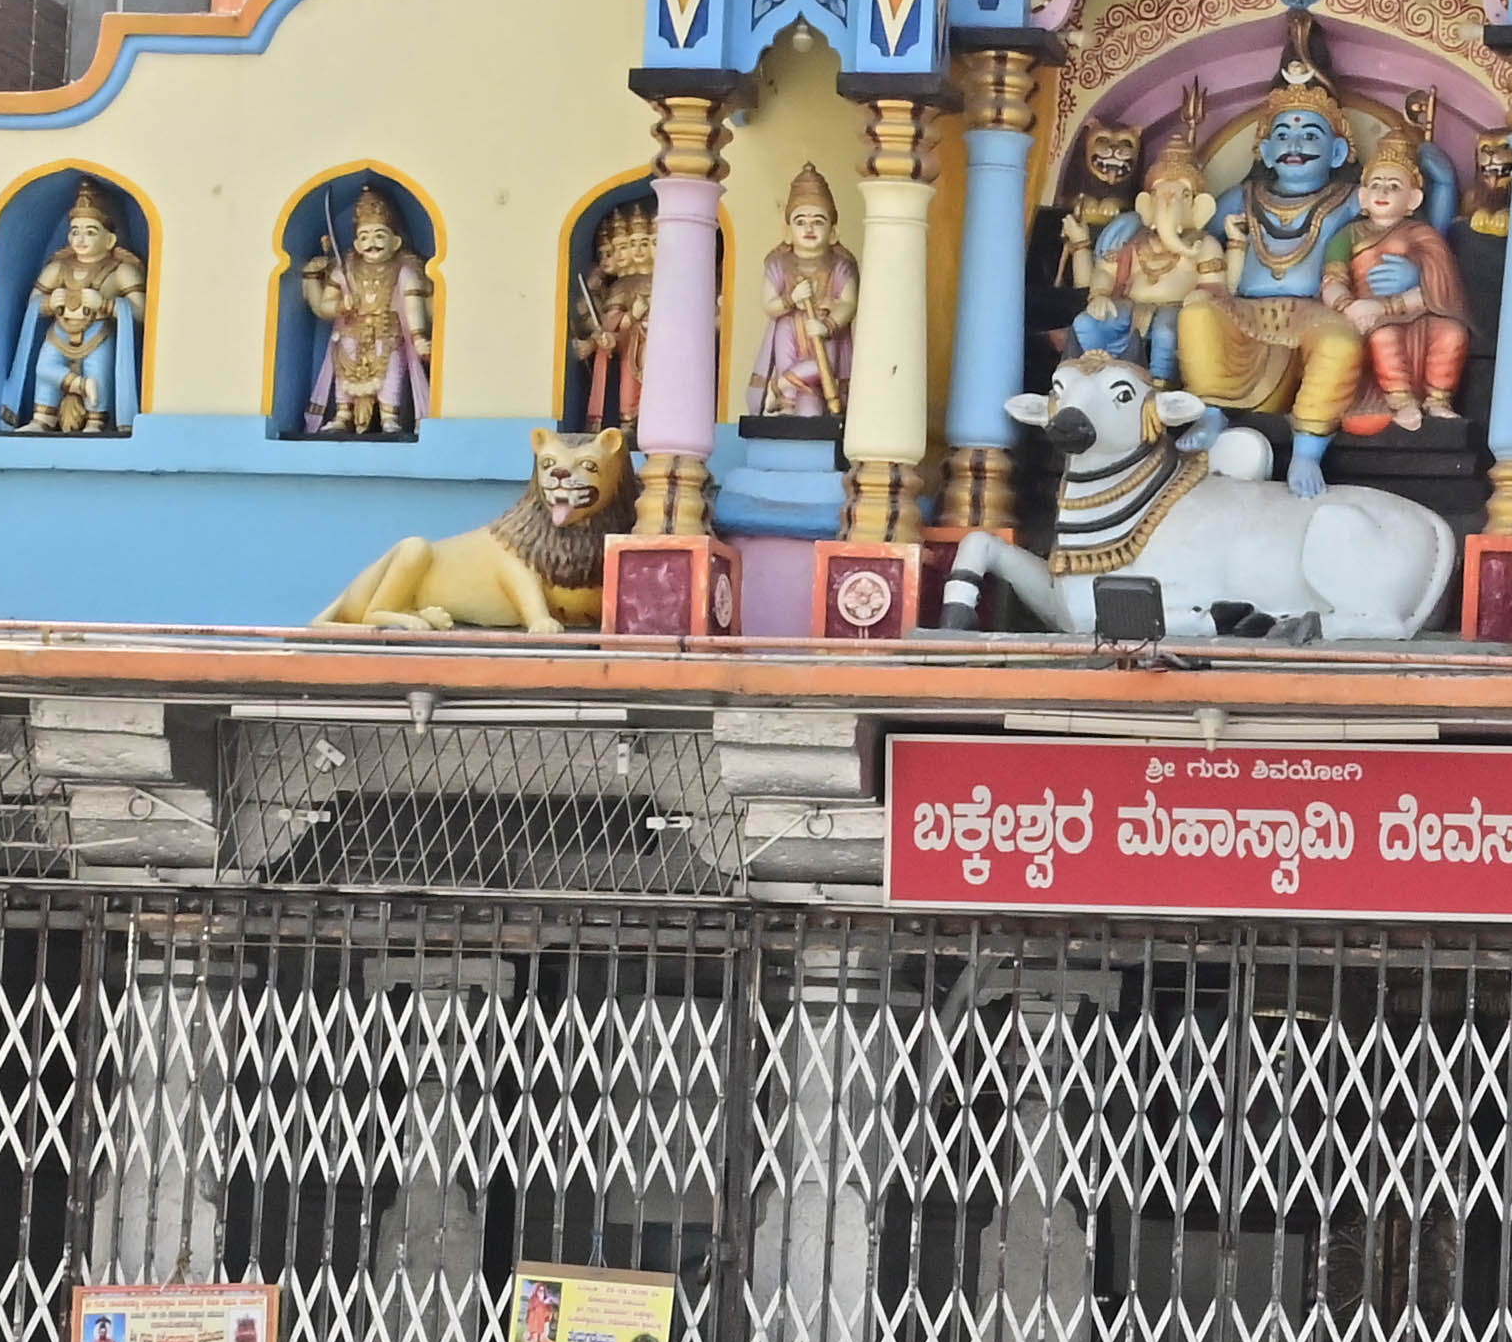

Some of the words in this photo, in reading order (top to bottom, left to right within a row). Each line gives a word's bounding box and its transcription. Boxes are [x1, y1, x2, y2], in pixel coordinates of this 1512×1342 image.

[1146, 758, 1175, 783] ಶ್ರೀ
[1188, 758, 1239, 778] ಗುರು
[1252, 760, 1362, 780] ಶಿವಯೋಗಿ
[914, 786, 1093, 888] ಬಕ್ಕೇಶ್ವರ
[1118, 790, 1354, 894] ಮಹಾಸ್ವಾಮಿ
